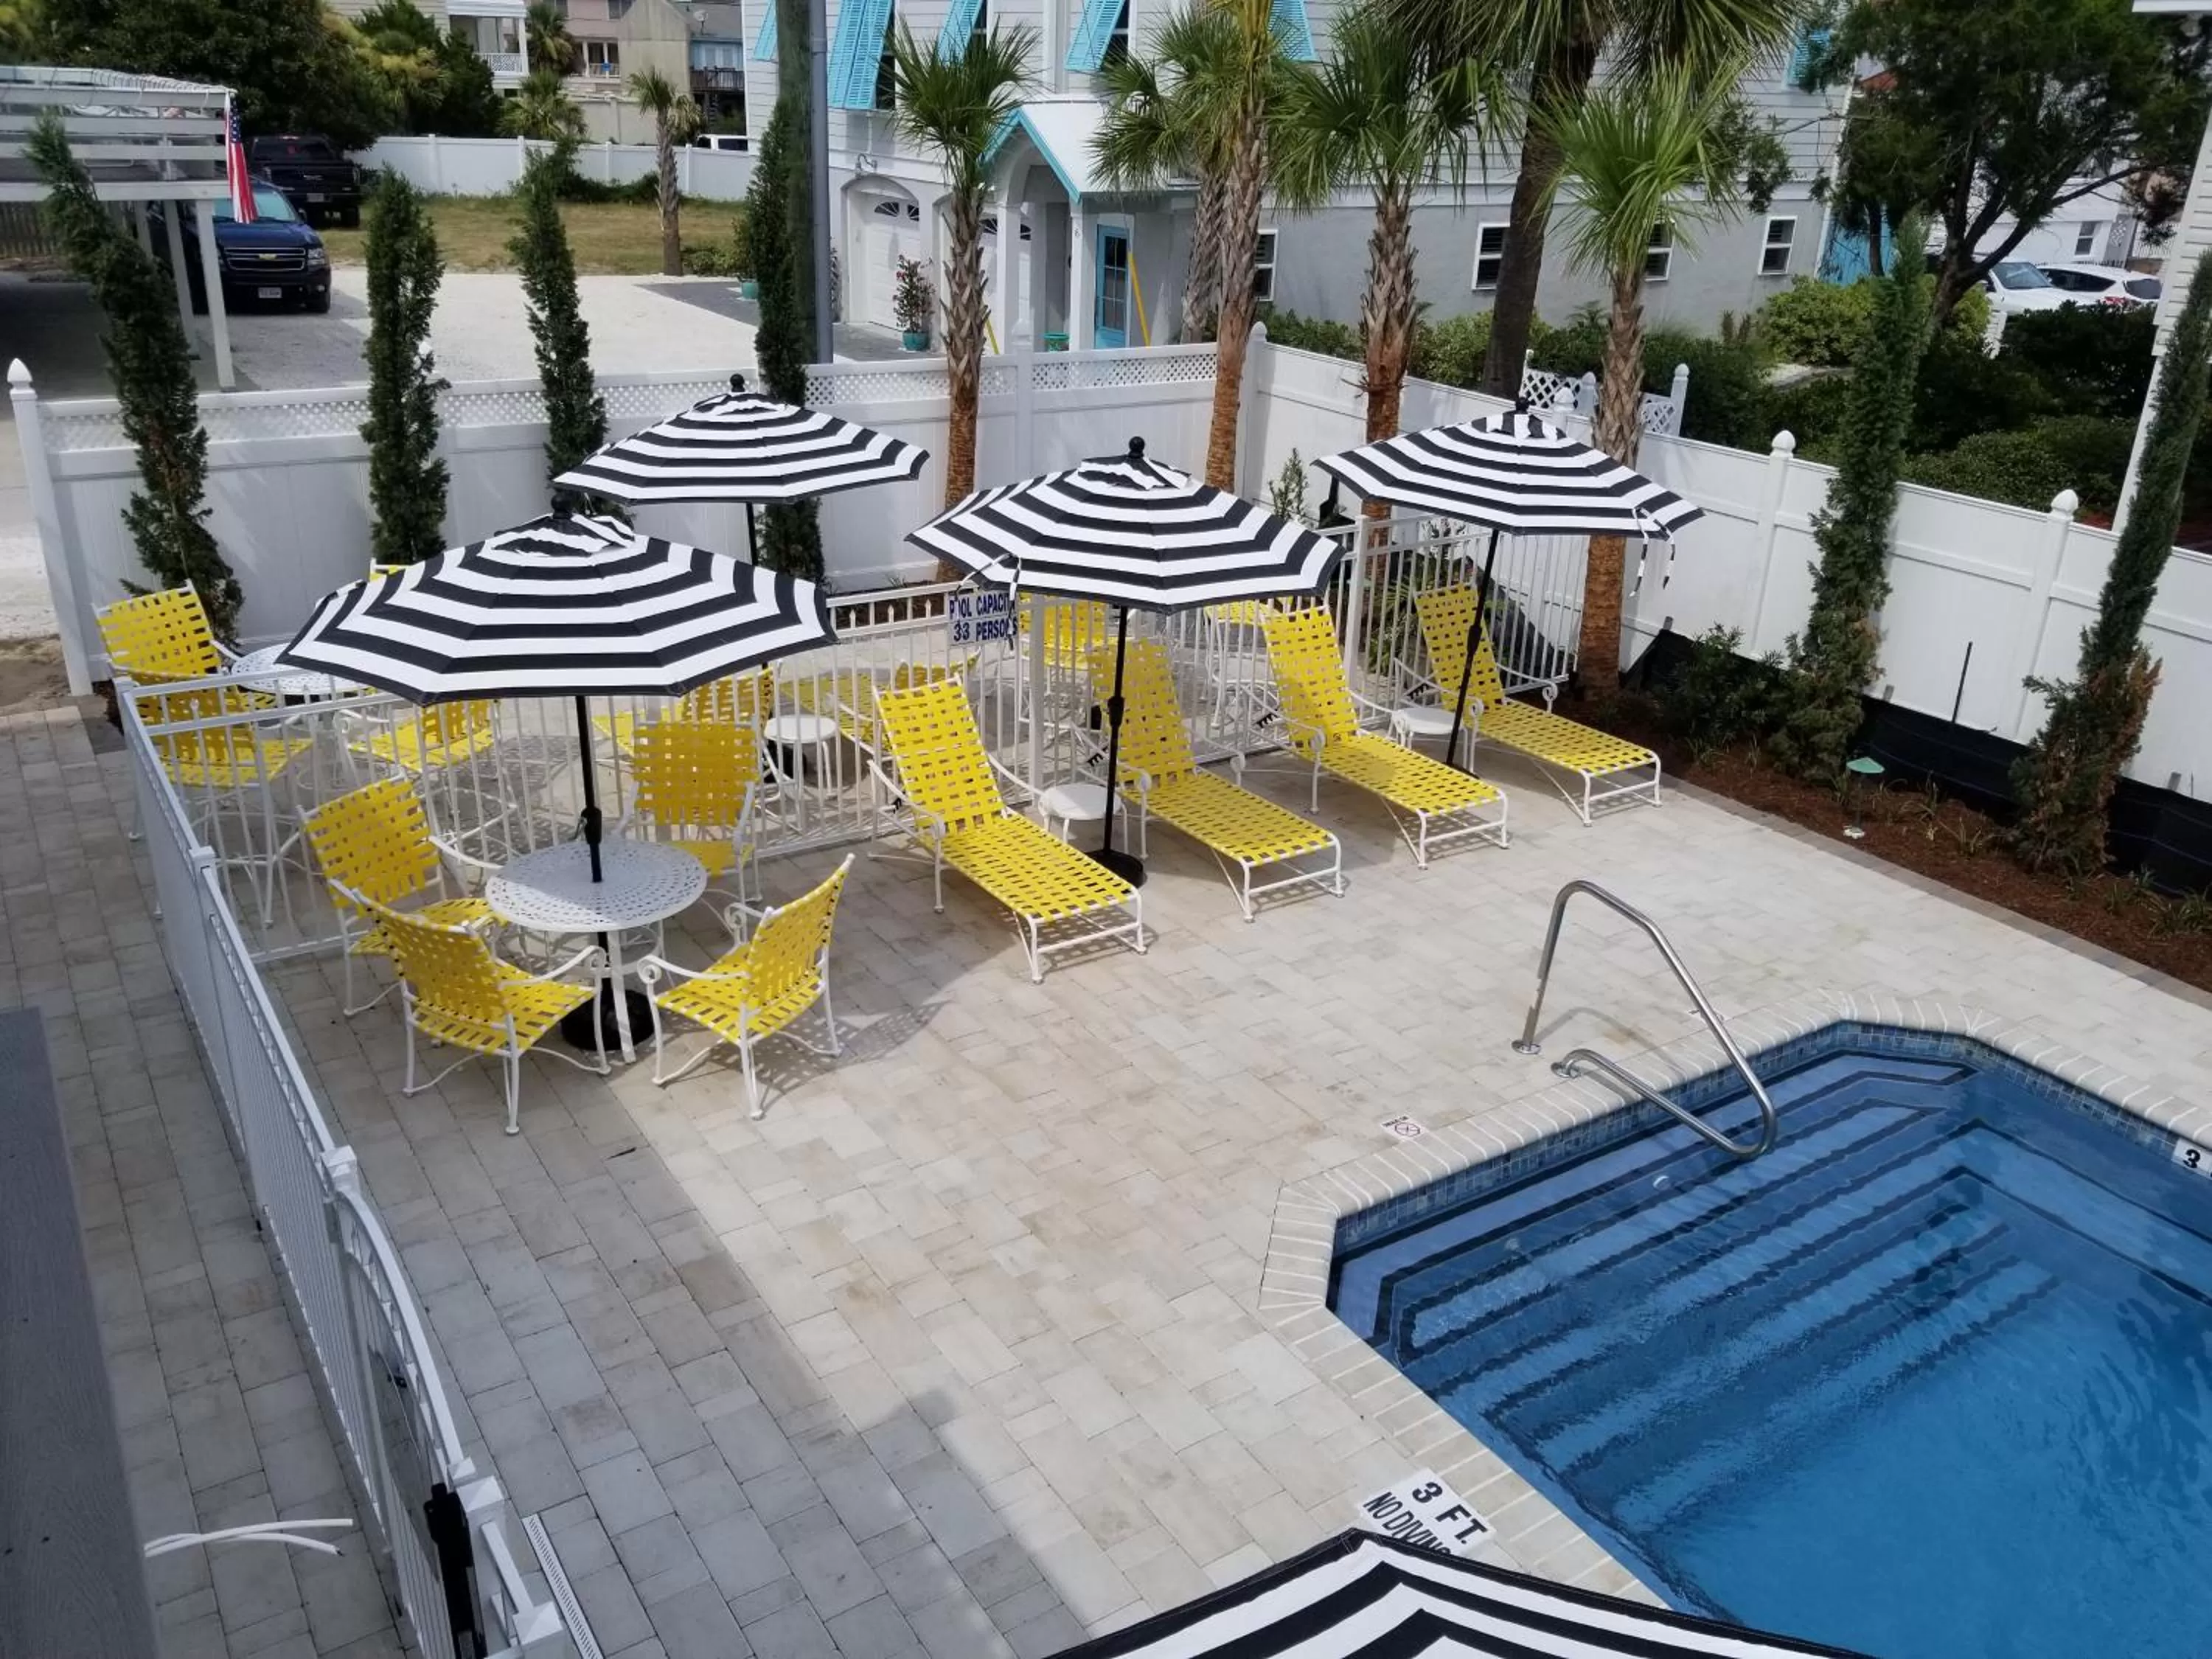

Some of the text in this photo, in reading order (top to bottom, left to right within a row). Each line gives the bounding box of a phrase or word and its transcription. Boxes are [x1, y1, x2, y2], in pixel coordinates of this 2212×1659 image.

[976, 592, 1015, 616] CAPACIT
[953, 621, 970, 641] 33
[2183, 1149, 2201, 1169] 3
[1363, 1492, 1402, 1520] NO
[1412, 1481, 1488, 1544] 3 FT.
